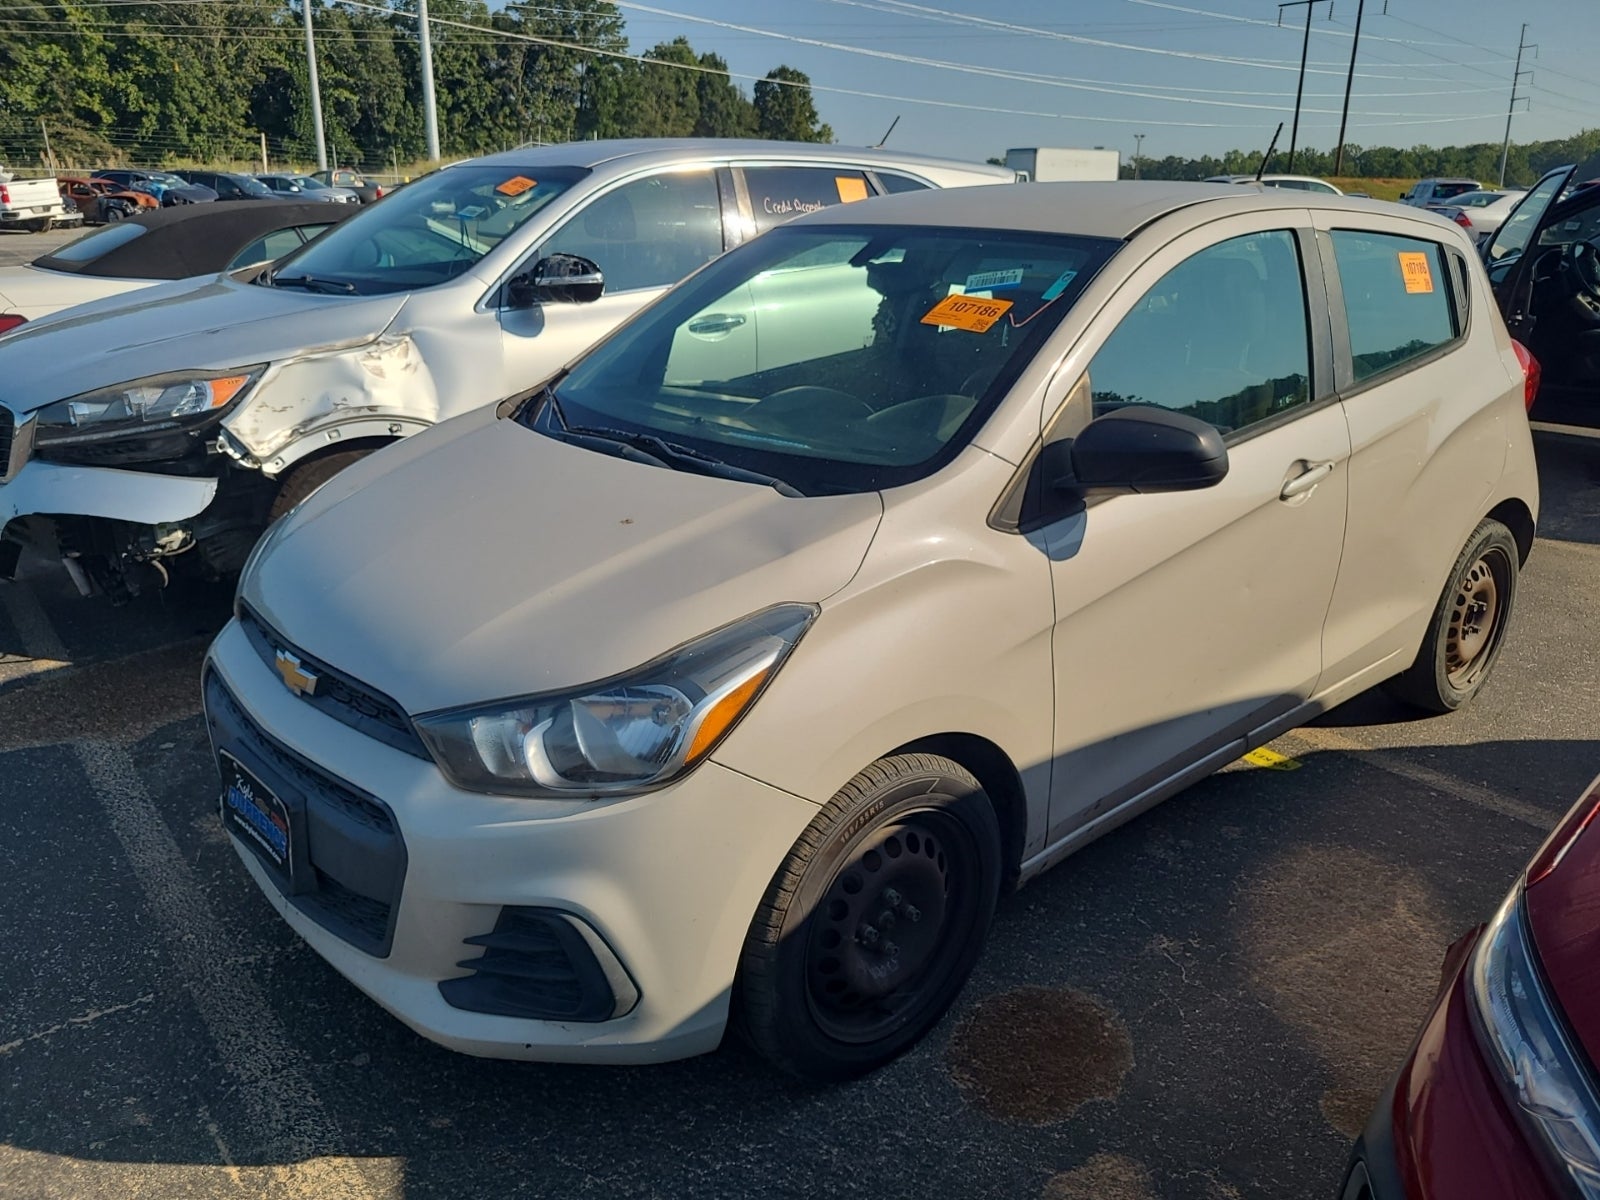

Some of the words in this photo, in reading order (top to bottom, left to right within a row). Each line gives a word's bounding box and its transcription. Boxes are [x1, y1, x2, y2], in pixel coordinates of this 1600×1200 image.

[1405, 262, 1427, 274] 107186
[949, 301, 1001, 318] 107186
[235, 774, 255, 802] Kyle
